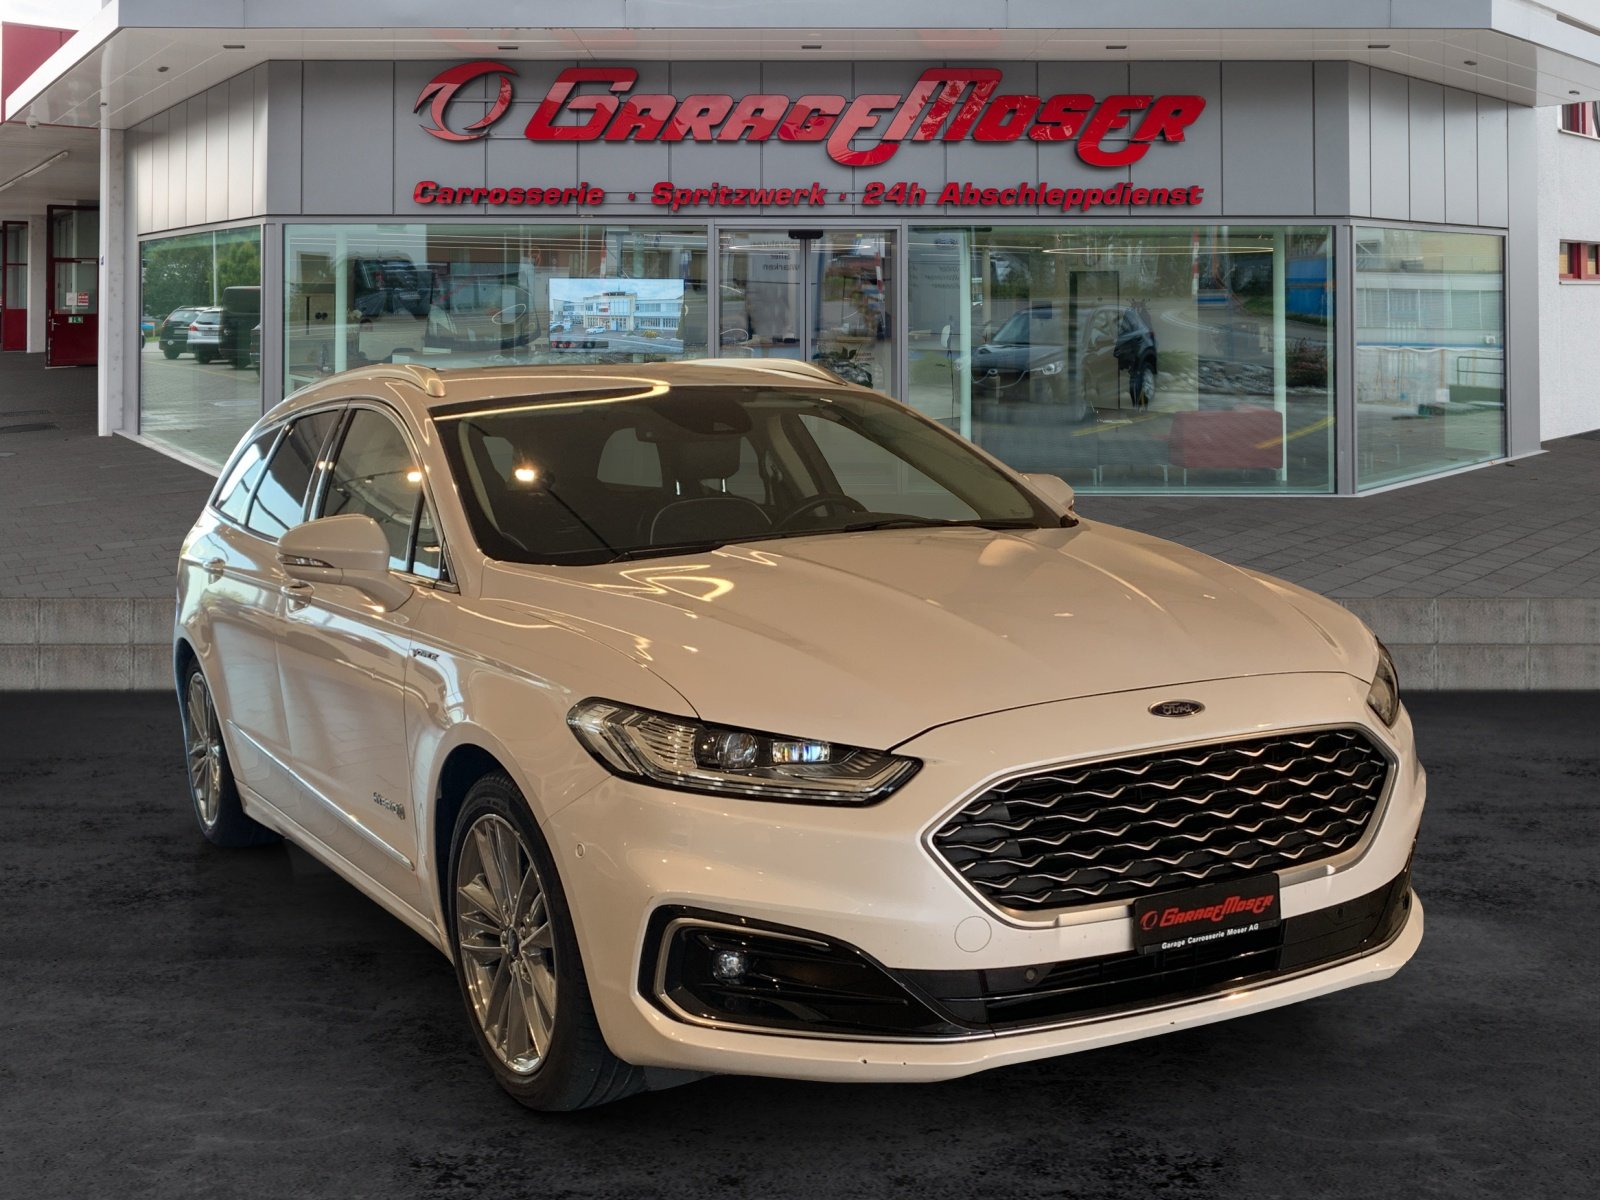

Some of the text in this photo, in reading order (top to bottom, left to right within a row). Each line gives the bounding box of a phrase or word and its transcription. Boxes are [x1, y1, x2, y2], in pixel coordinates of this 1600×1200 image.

[413, 180, 1205, 212] Carrosserie Spritzwerk 24h Abschleppdienst
[1161, 939, 1186, 950] Garage
[1226, 925, 1248, 936] Moser
[1248, 922, 1259, 931] AG
